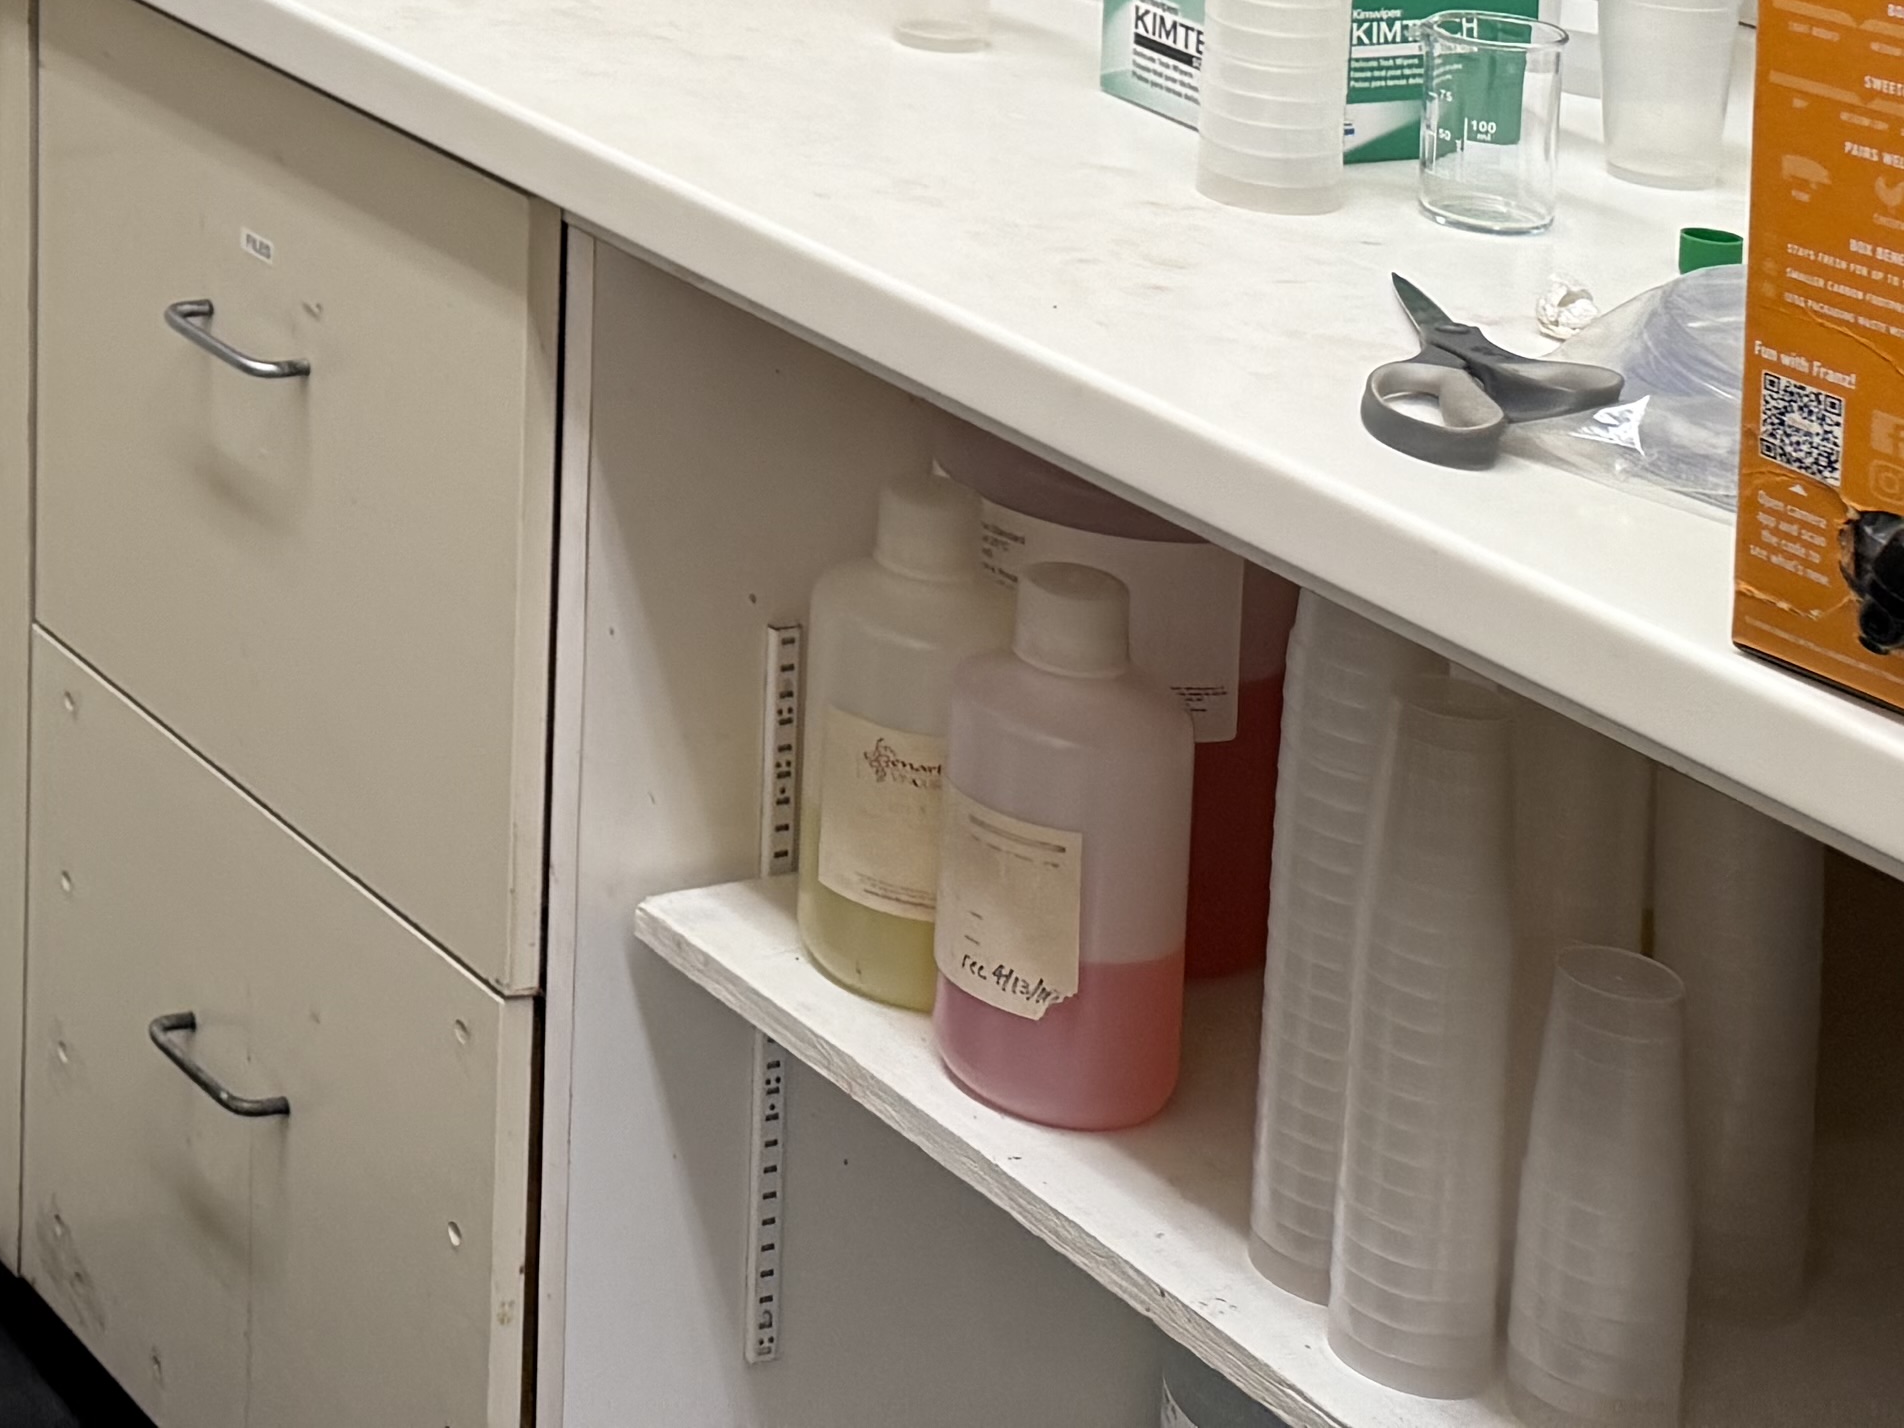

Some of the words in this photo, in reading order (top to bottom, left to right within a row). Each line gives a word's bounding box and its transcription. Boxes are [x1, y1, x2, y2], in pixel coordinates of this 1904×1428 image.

[1352, 8, 1402, 20] Kimwipes
[1135, 5, 1205, 56] KIMTE
[1395, 57, 1419, 67] Wipers
[1439, 90, 1452, 102] 75
[1438, 128, 1451, 141] 50
[1471, 120, 1497, 134] 100
[1844, 141, 1879, 162] PAIRS
[1787, 243, 1815, 260] STAYS
[1817, 252, 1847, 270] FRESH
[1849, 263, 1868, 277] FOR
[1871, 270, 1884, 281] UP
[1887, 274, 1899, 286] TO
[1827, 281, 1864, 299] CARBON
[1754, 340, 1778, 361] Fun
[1780, 352, 1810, 373] with
[1811, 361, 1857, 390] Franz!
[1757, 490, 1785, 512] Open
[1787, 504, 1827, 529] camera
[1778, 521, 1799, 537] and
[992, 964, 1060, 1004] 4/13/
